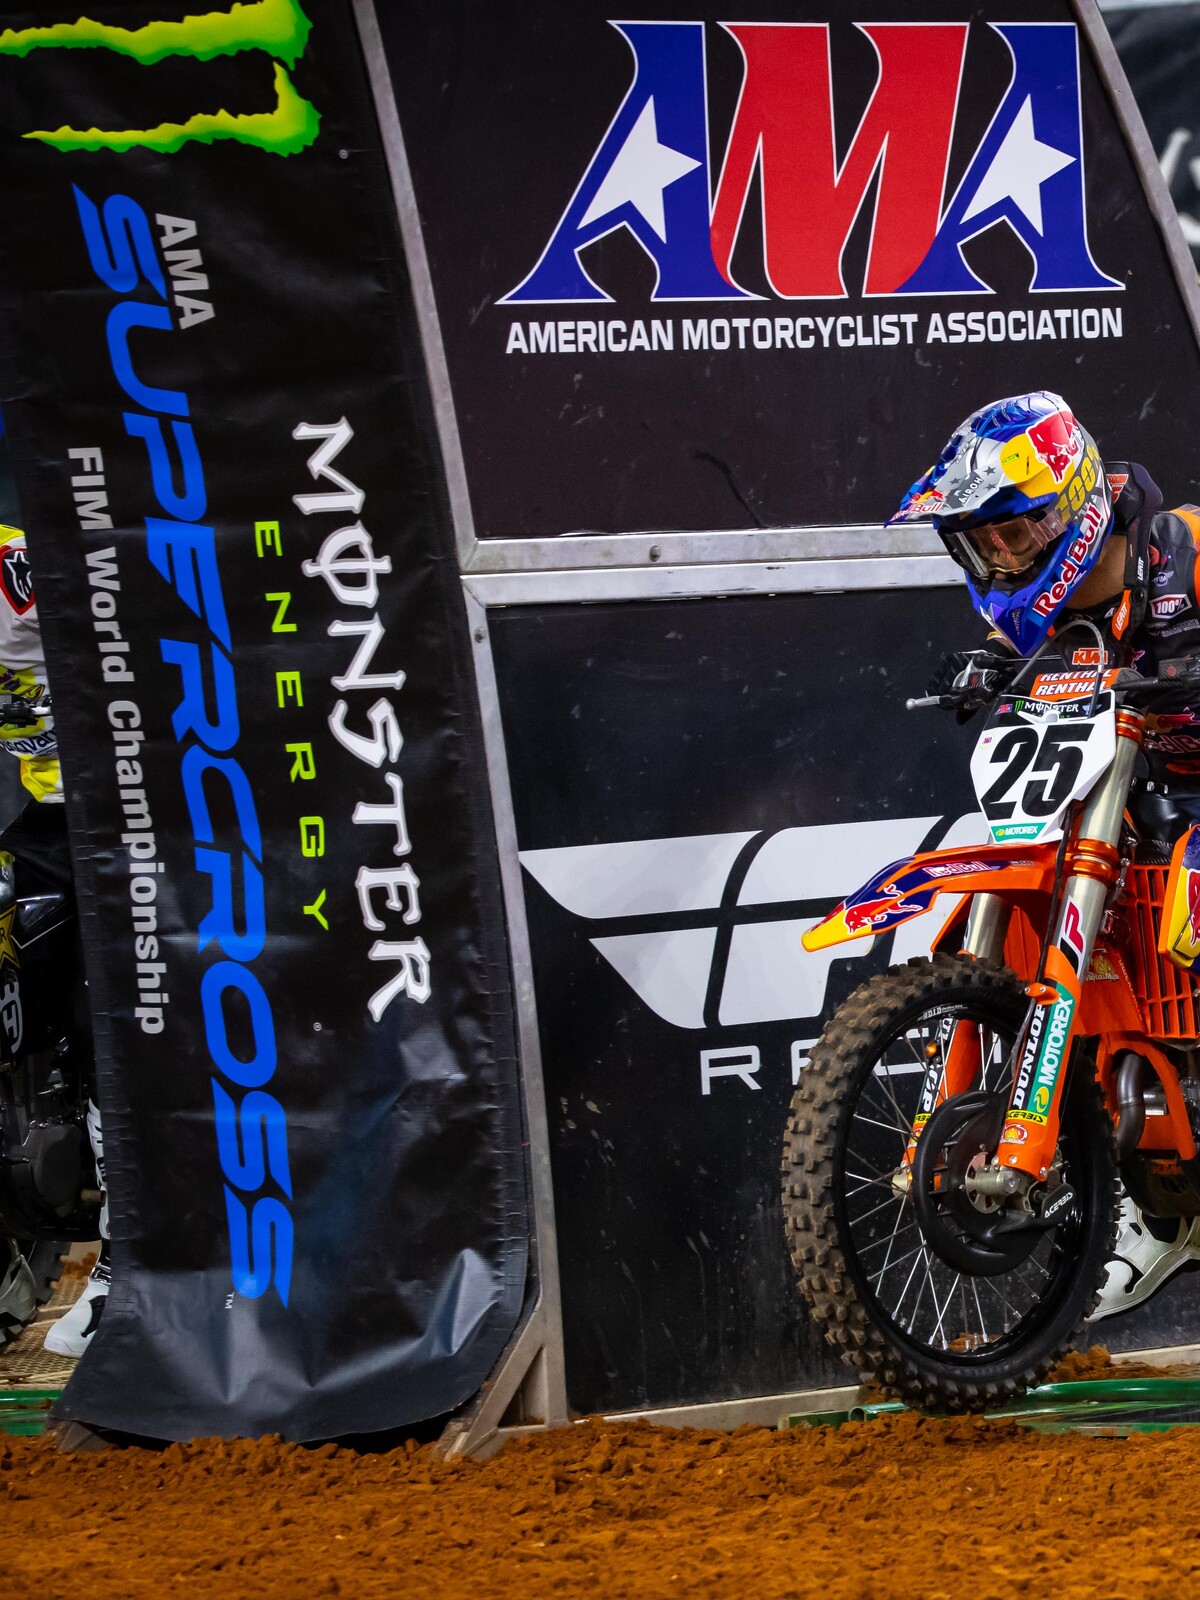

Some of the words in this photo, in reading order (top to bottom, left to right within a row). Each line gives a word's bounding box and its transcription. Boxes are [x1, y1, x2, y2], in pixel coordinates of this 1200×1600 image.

[494, 20, 1126, 304] AMA
[155, 212, 215, 330] AMA
[505, 317, 675, 355] AMERICAN
[682, 312, 920, 351] MOTORCYCLIST
[926, 307, 1123, 346] ASSOCIATION
[68, 447, 114, 530] FIM
[958, 476, 984, 504] AIROH
[1032, 558, 1079, 617] Red
[1066, 502, 1102, 566] Bull
[1156, 598, 1185, 614] 100%
[85, 546, 135, 683] World
[1072, 648, 1108, 665] KTM
[254, 520, 330, 931] ENERGY
[292, 415, 431, 1023] MONSTER
[1034, 681, 1107, 696] RENTHAL
[72, 182, 294, 1309] SUPERCROSS
[980, 722, 1095, 821] 25
[107, 700, 169, 1035] Championship
[1005, 825, 1038, 836] MOTOREX
[1012, 1004, 1046, 1111] DUNLOP
[1038, 997, 1074, 1087] MOTOREX
[1005, 1110, 1044, 1124] ACERBIS
[1044, 1191, 1074, 1219] ACERBIS
